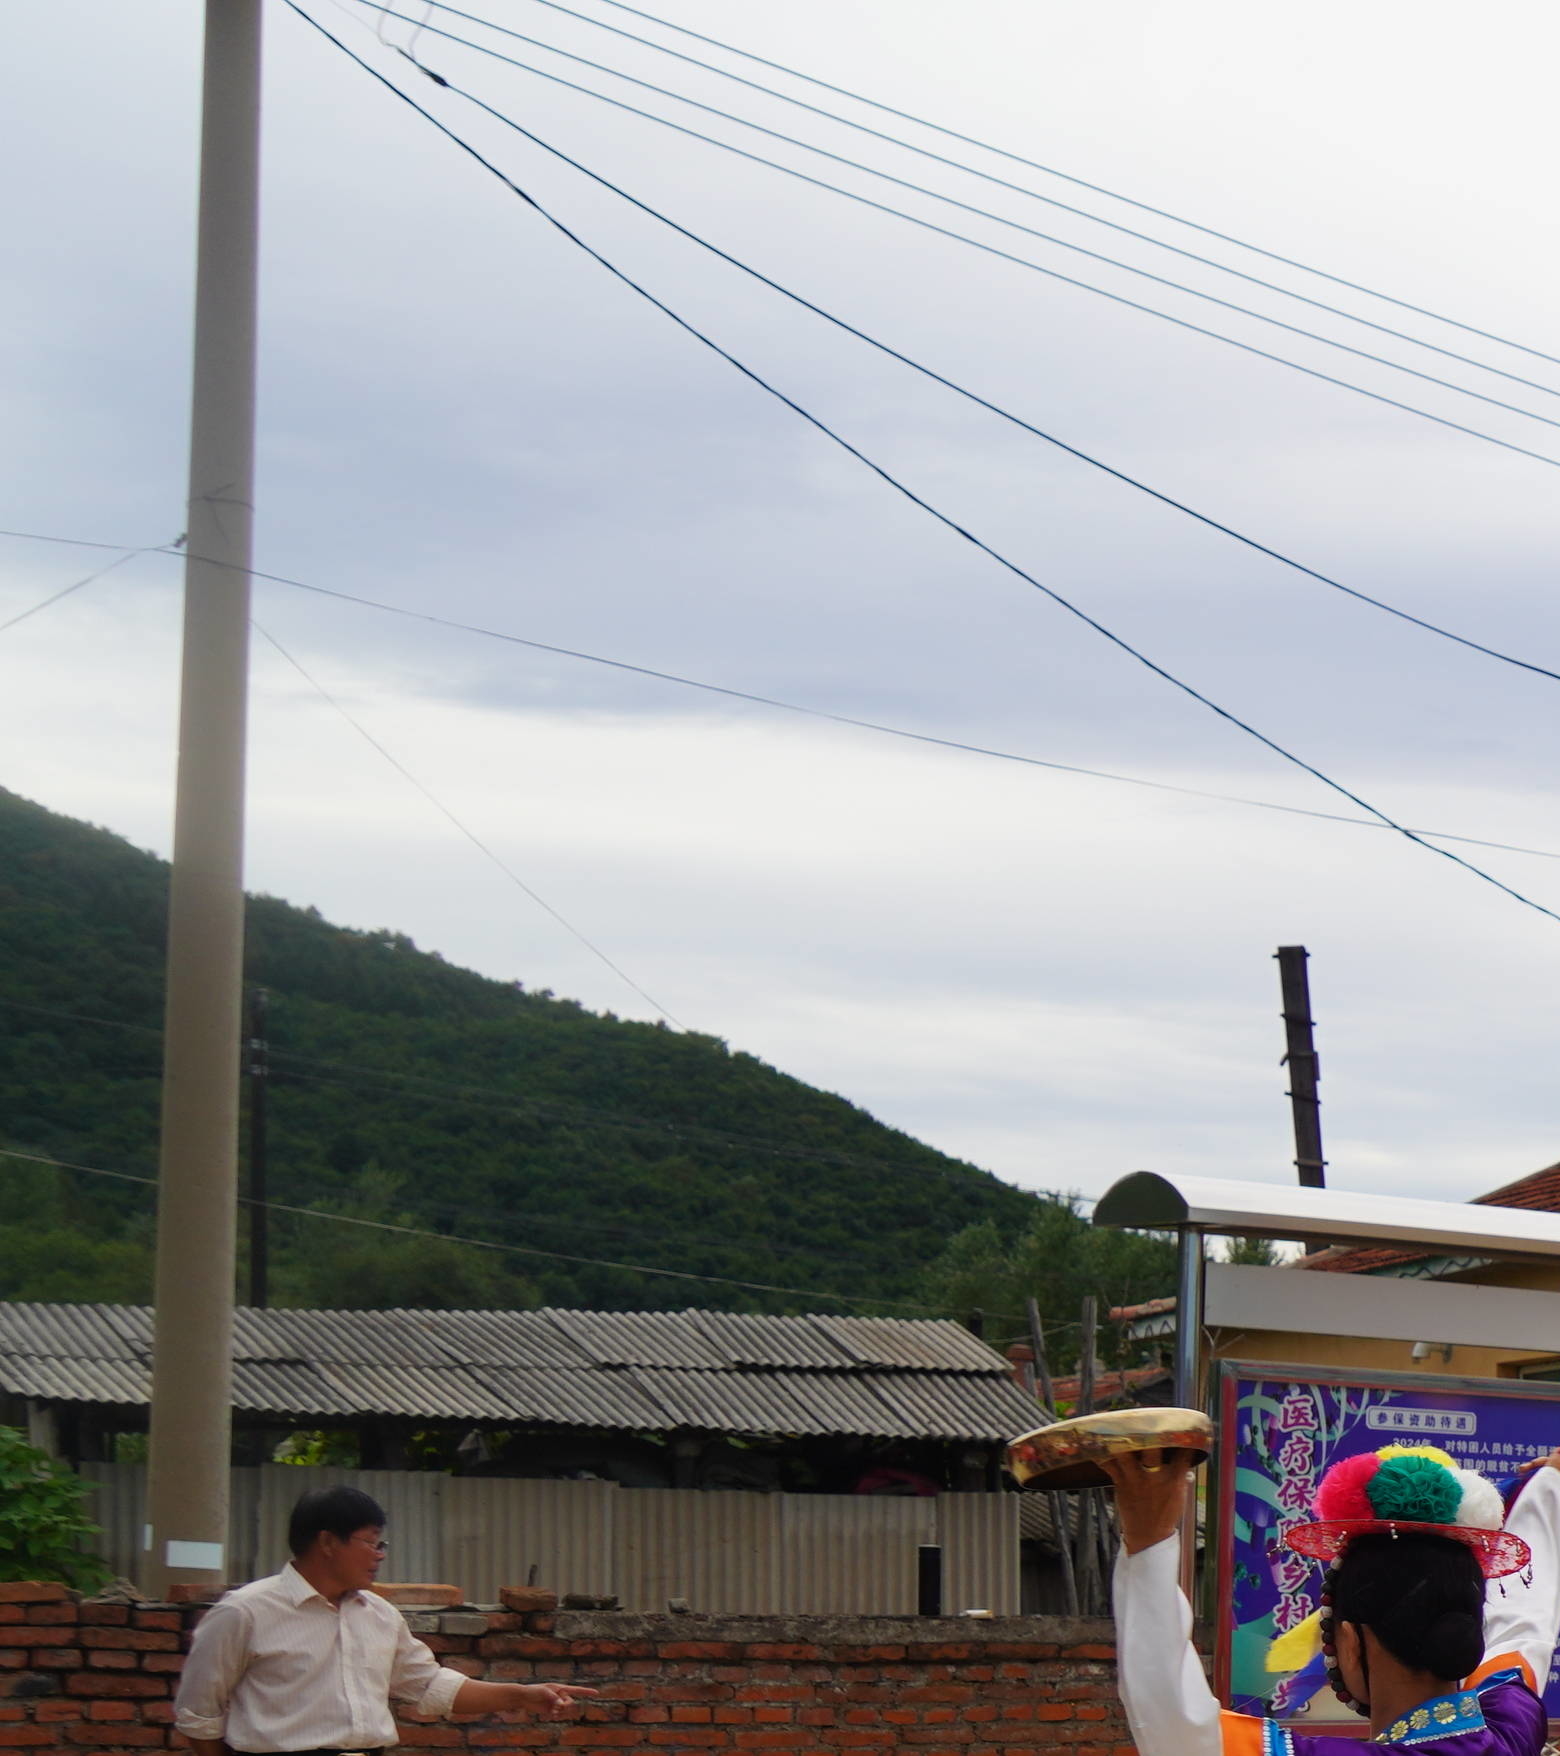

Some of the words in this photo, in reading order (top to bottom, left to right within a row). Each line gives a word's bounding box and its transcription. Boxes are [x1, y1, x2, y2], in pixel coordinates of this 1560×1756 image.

[1376, 1411, 1467, 1430] 参保资助待遇
[1275, 1395, 1318, 1711] 医疗保乡村
